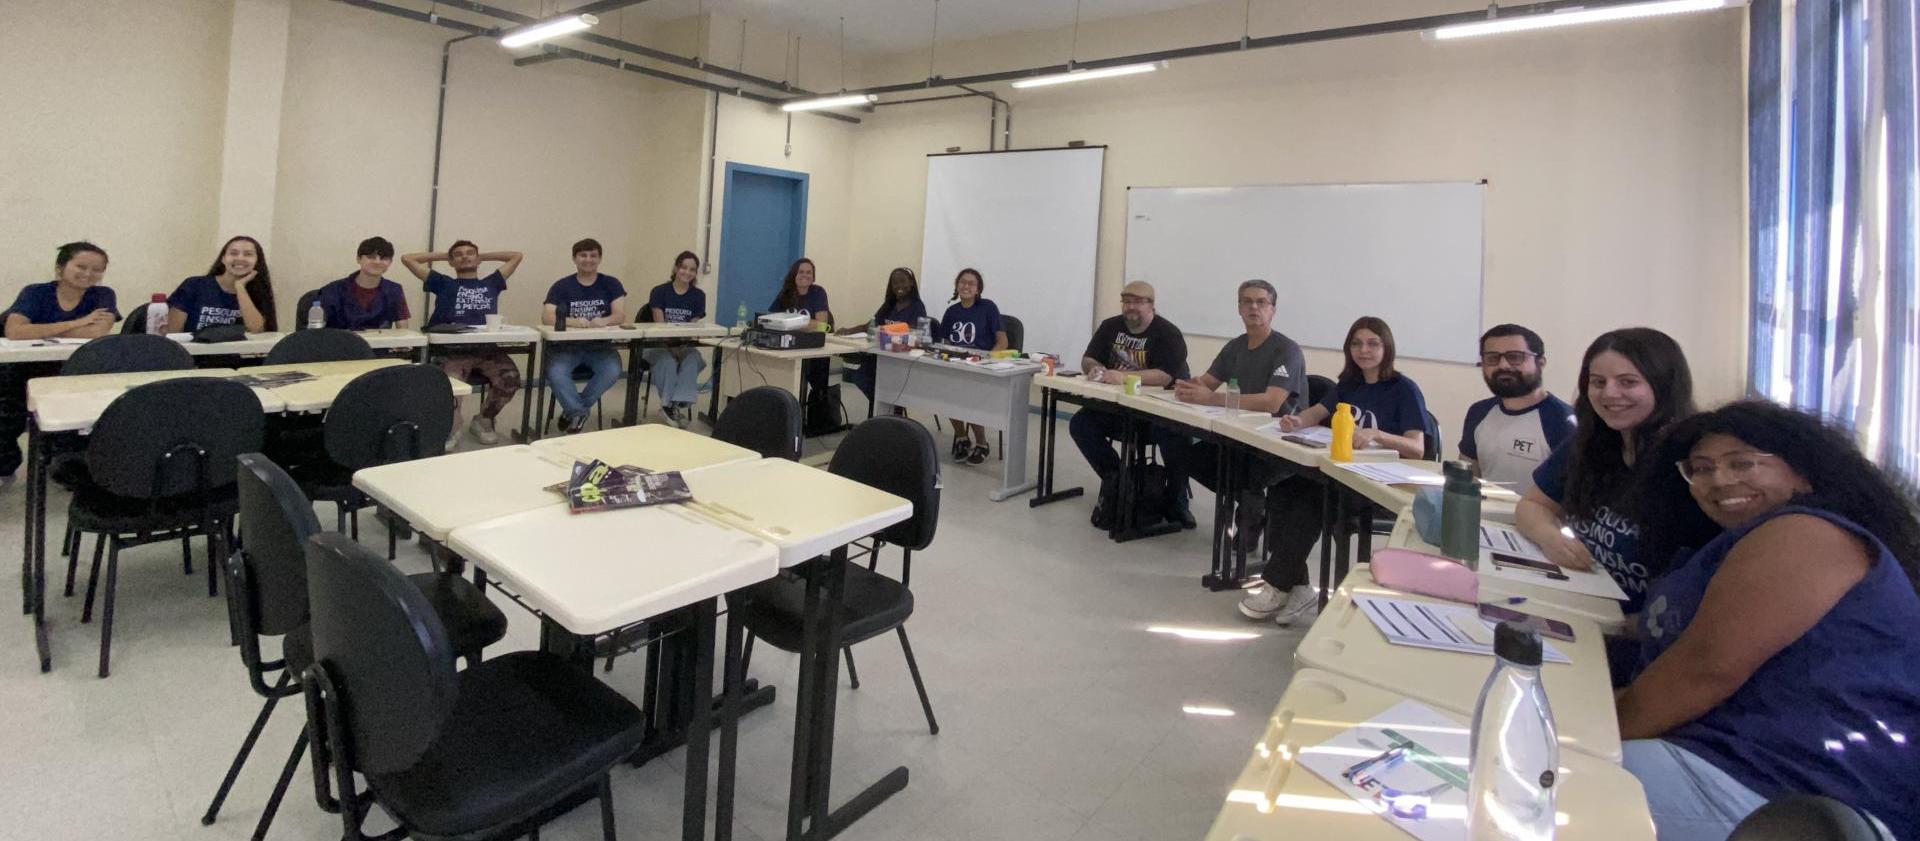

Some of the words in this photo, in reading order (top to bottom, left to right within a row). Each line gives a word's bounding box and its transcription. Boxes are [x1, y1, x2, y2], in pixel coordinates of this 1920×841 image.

[201, 306, 241, 317] PESQUIS
[570, 299, 604, 308] PESQUISA
[949, 321, 976, 345] 30
[1513, 439, 1534, 453] PET
[1565, 514, 1615, 549] NSINO
[1595, 506, 1639, 540] QUISA
